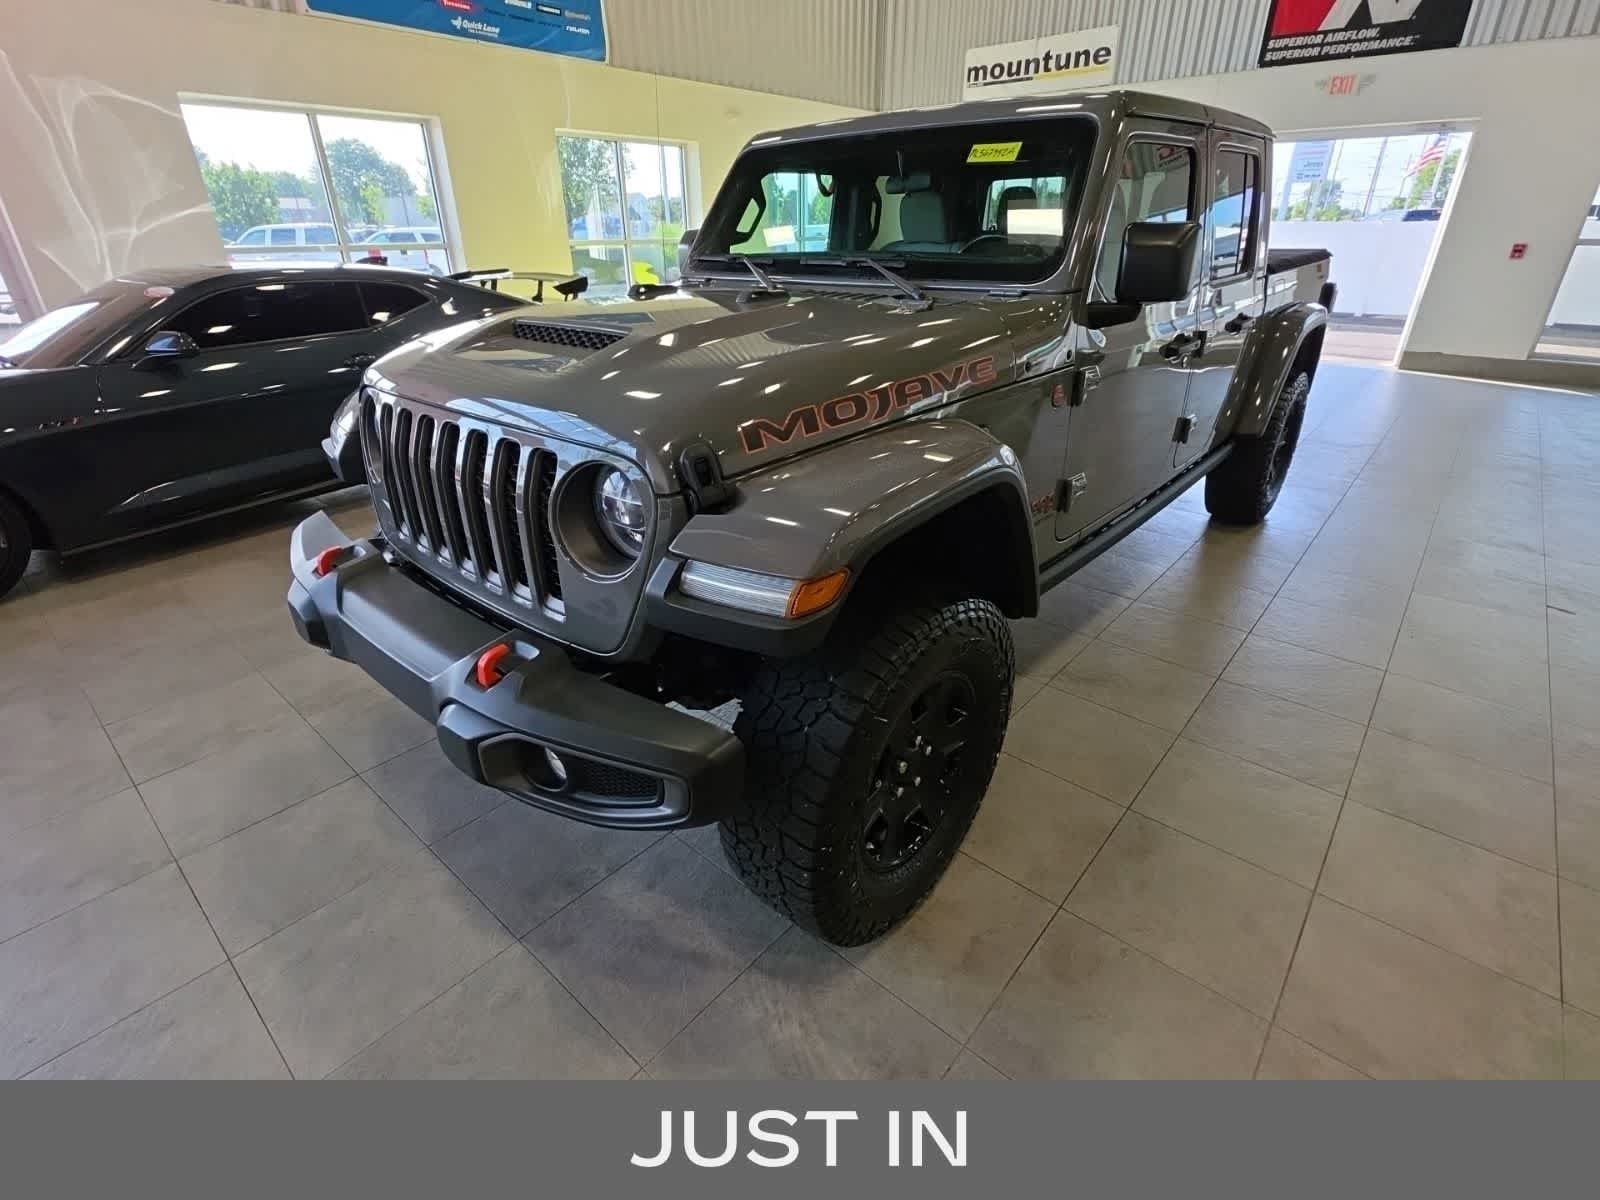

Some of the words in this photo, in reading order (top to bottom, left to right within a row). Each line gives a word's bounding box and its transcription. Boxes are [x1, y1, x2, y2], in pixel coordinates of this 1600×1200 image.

[462, 19, 482, 30] Quick
[483, 23, 500, 34] Lane
[1267, 34, 1324, 49] SUPERIOR
[1324, 27, 1380, 43] AIRFLOW.
[1264, 46, 1321, 61] SUPERIOR
[967, 46, 1112, 83] mountune
[1329, 74, 1356, 95] EXIT
[738, 357, 997, 454] MOJAVE
